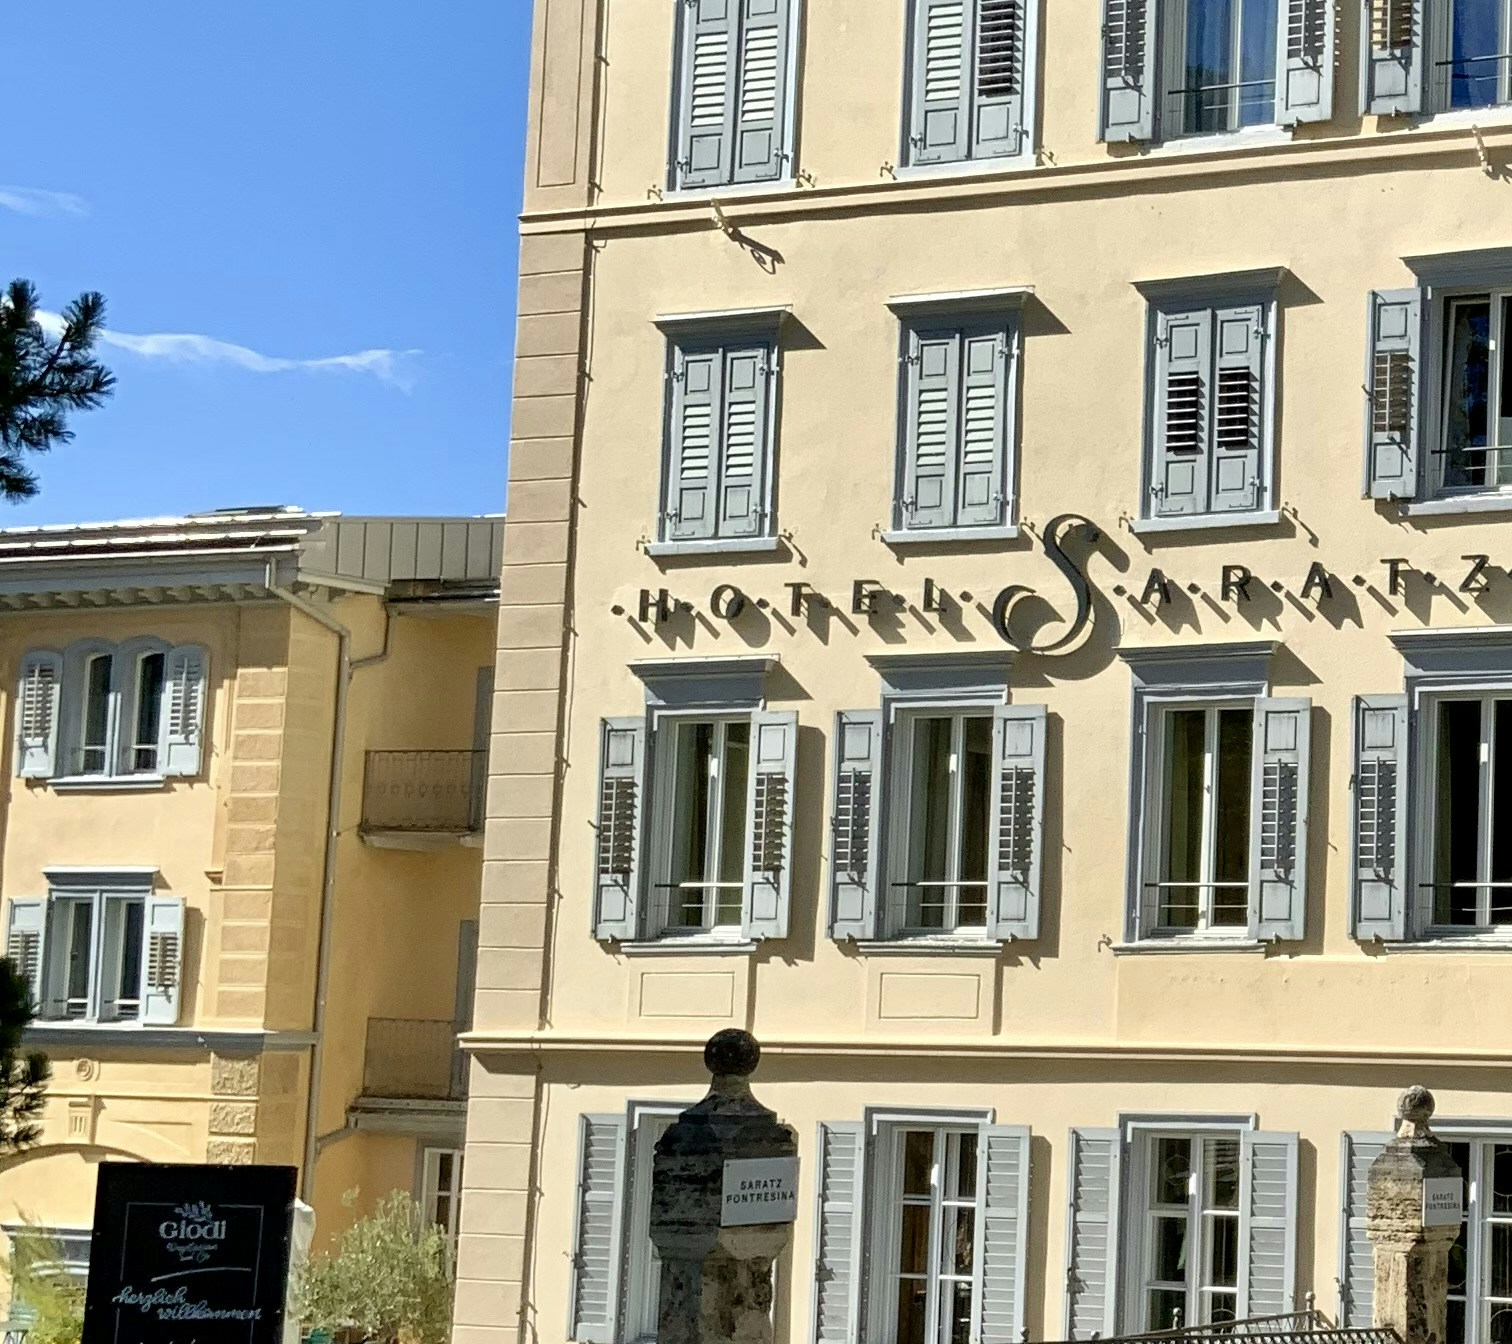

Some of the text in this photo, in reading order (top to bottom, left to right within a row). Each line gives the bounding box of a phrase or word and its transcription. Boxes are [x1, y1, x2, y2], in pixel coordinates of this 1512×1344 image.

[638, 513, 1491, 653] HOTEL SARATZ
[740, 1178, 783, 1191] SARATZ
[726, 1190, 795, 1205] PONTRESINA
[159, 1219, 227, 1240] Giodi
